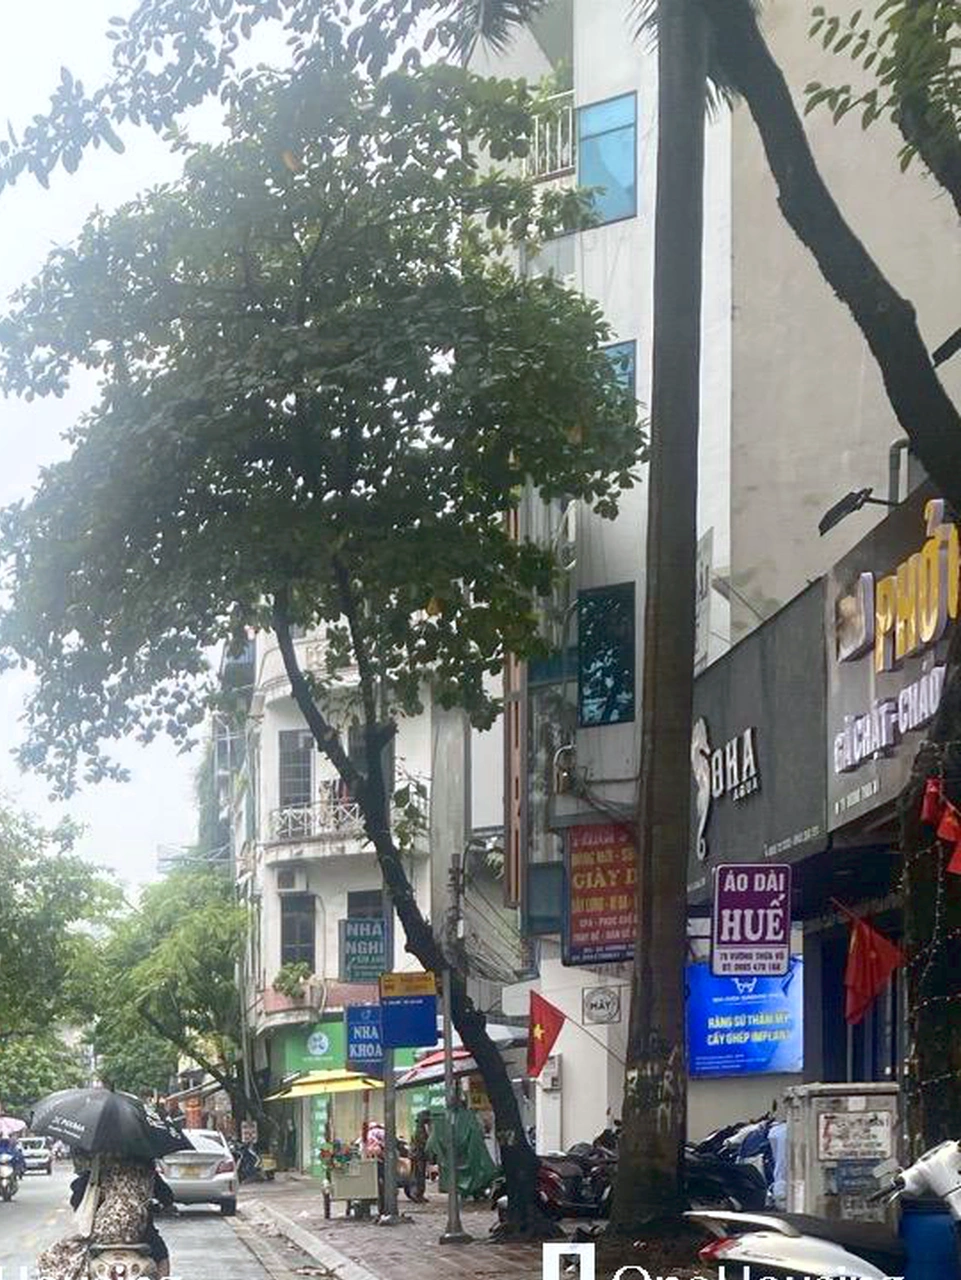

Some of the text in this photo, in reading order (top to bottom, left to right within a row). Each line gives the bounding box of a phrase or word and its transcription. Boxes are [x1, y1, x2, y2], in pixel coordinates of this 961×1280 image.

[723, 869, 748, 892] ÁO
[753, 869, 784, 892] DÀI
[720, 893, 786, 941] HUẾ
[349, 1043, 383, 1058] KHOA
